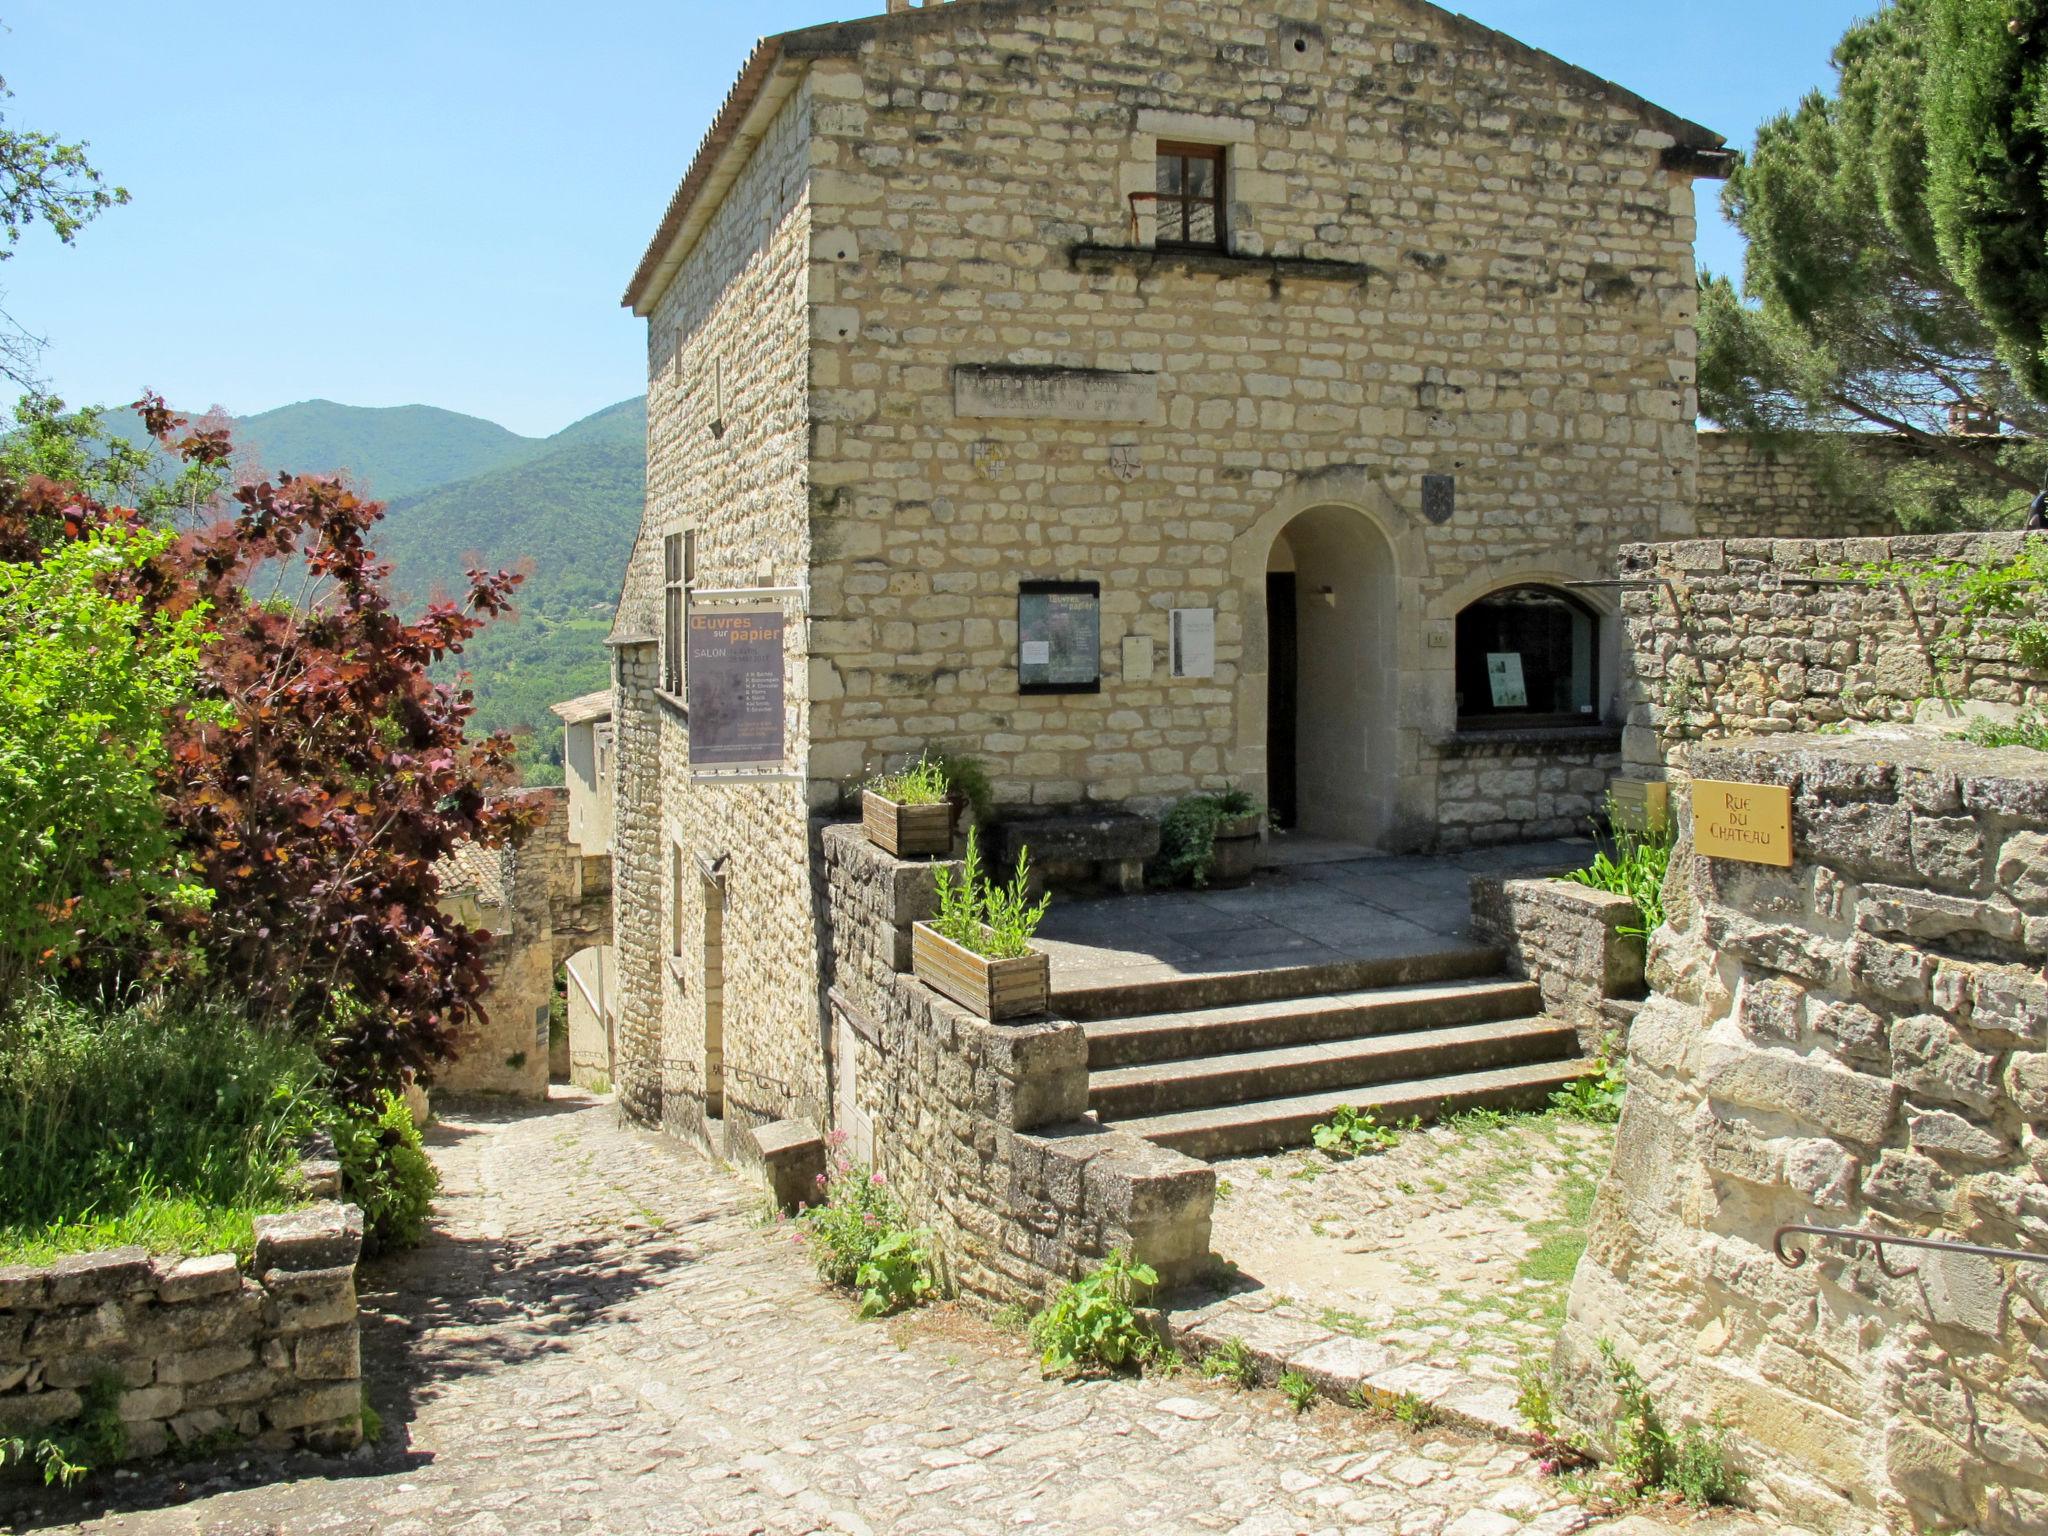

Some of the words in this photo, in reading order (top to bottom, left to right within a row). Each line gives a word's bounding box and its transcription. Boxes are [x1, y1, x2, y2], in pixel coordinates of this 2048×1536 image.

[690, 615, 752, 630] Œuvres
[713, 630, 728, 638] sur
[730, 626, 780, 644] papier
[694, 648, 727, 658] SALON
[1725, 793, 1751, 812] RUE
[1729, 812, 1748, 826] DU
[1710, 822, 1771, 844] CHATEAU
